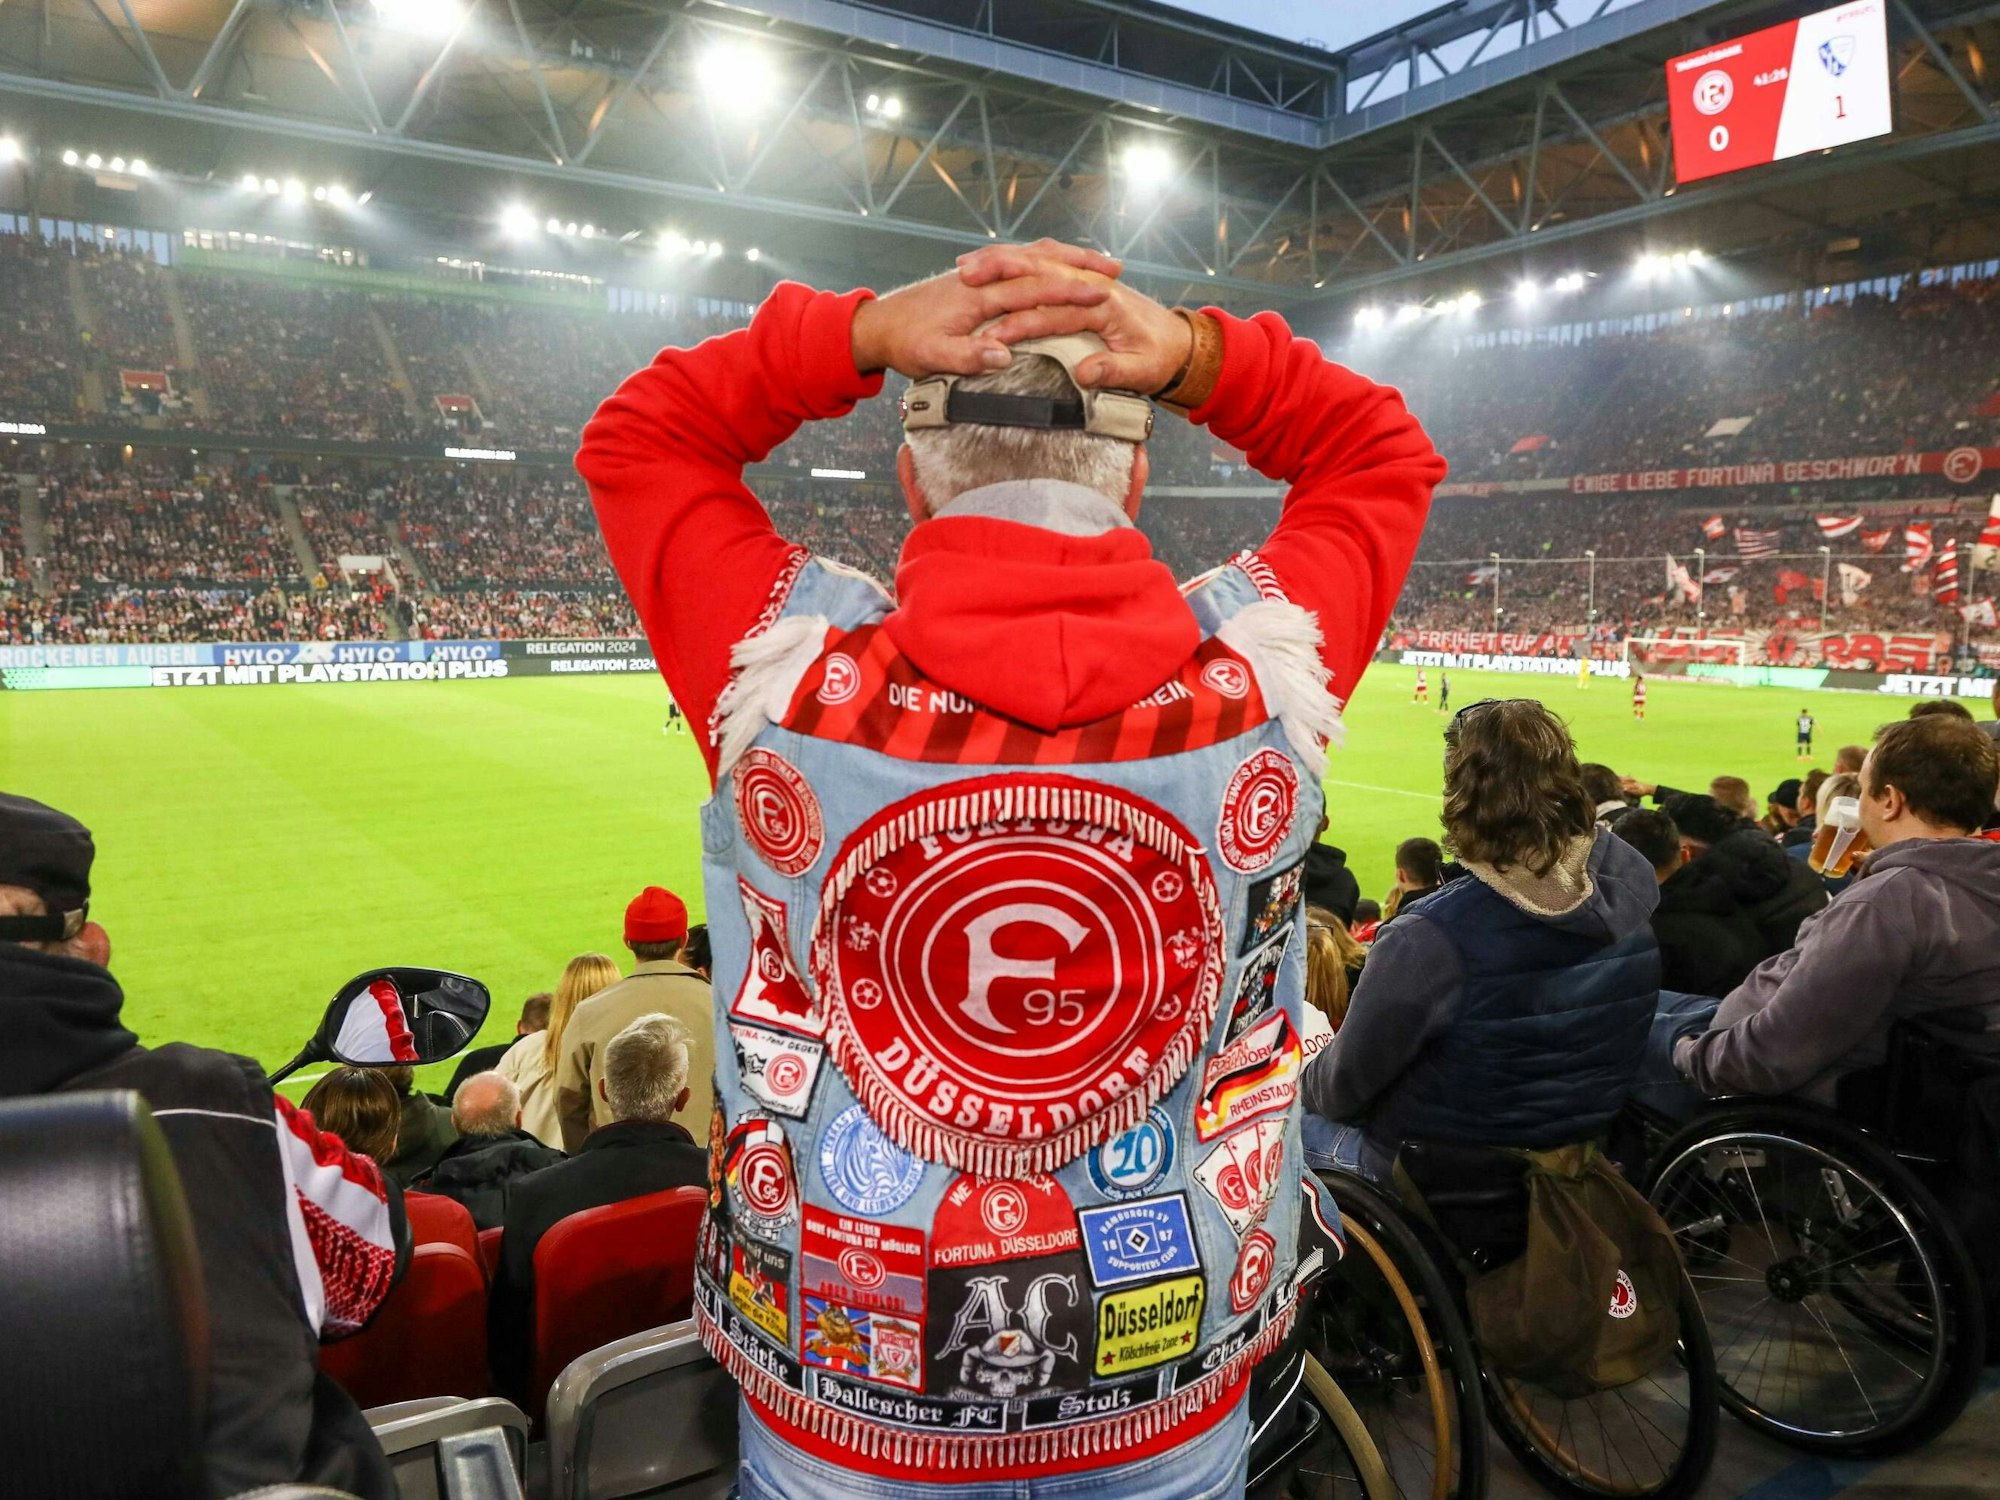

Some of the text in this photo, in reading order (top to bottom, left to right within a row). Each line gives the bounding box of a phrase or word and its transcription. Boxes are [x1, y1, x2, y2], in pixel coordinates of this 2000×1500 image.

[1835, 96, 1847, 119] 1
[1709, 125, 1729, 151] 0
[1626, 470, 1679, 490] LIEBE
[1685, 462, 1775, 488] FORTUNA
[526, 641, 637, 654] RELEGATION 2024
[224, 665, 275, 684] MIT
[278, 660, 446, 684] PLAYSTATION
[449, 659, 508, 679] PLUS
[551, 658, 657, 672] RELEGATION 2024
[888, 682, 923, 712] DIE
[1878, 674, 1958, 694] JETZT
[874, 1036, 1152, 1140] DÜSSELDORF
[949, 1181, 973, 1208] WE
[1100, 1208, 1155, 1234] HAMBURGER
[934, 1241, 996, 1265] FORTUNA
[1107, 1256, 1161, 1272] SUPPORTERS
[1104, 1283, 1200, 1341] Düsseldorf
[729, 1316, 789, 1382] Stärke
[1201, 1332, 1246, 1370] Ehre
[820, 1377, 943, 1424] Hallescher
[950, 1405, 998, 1428] FC
[1057, 1387, 1133, 1420] Stolz
